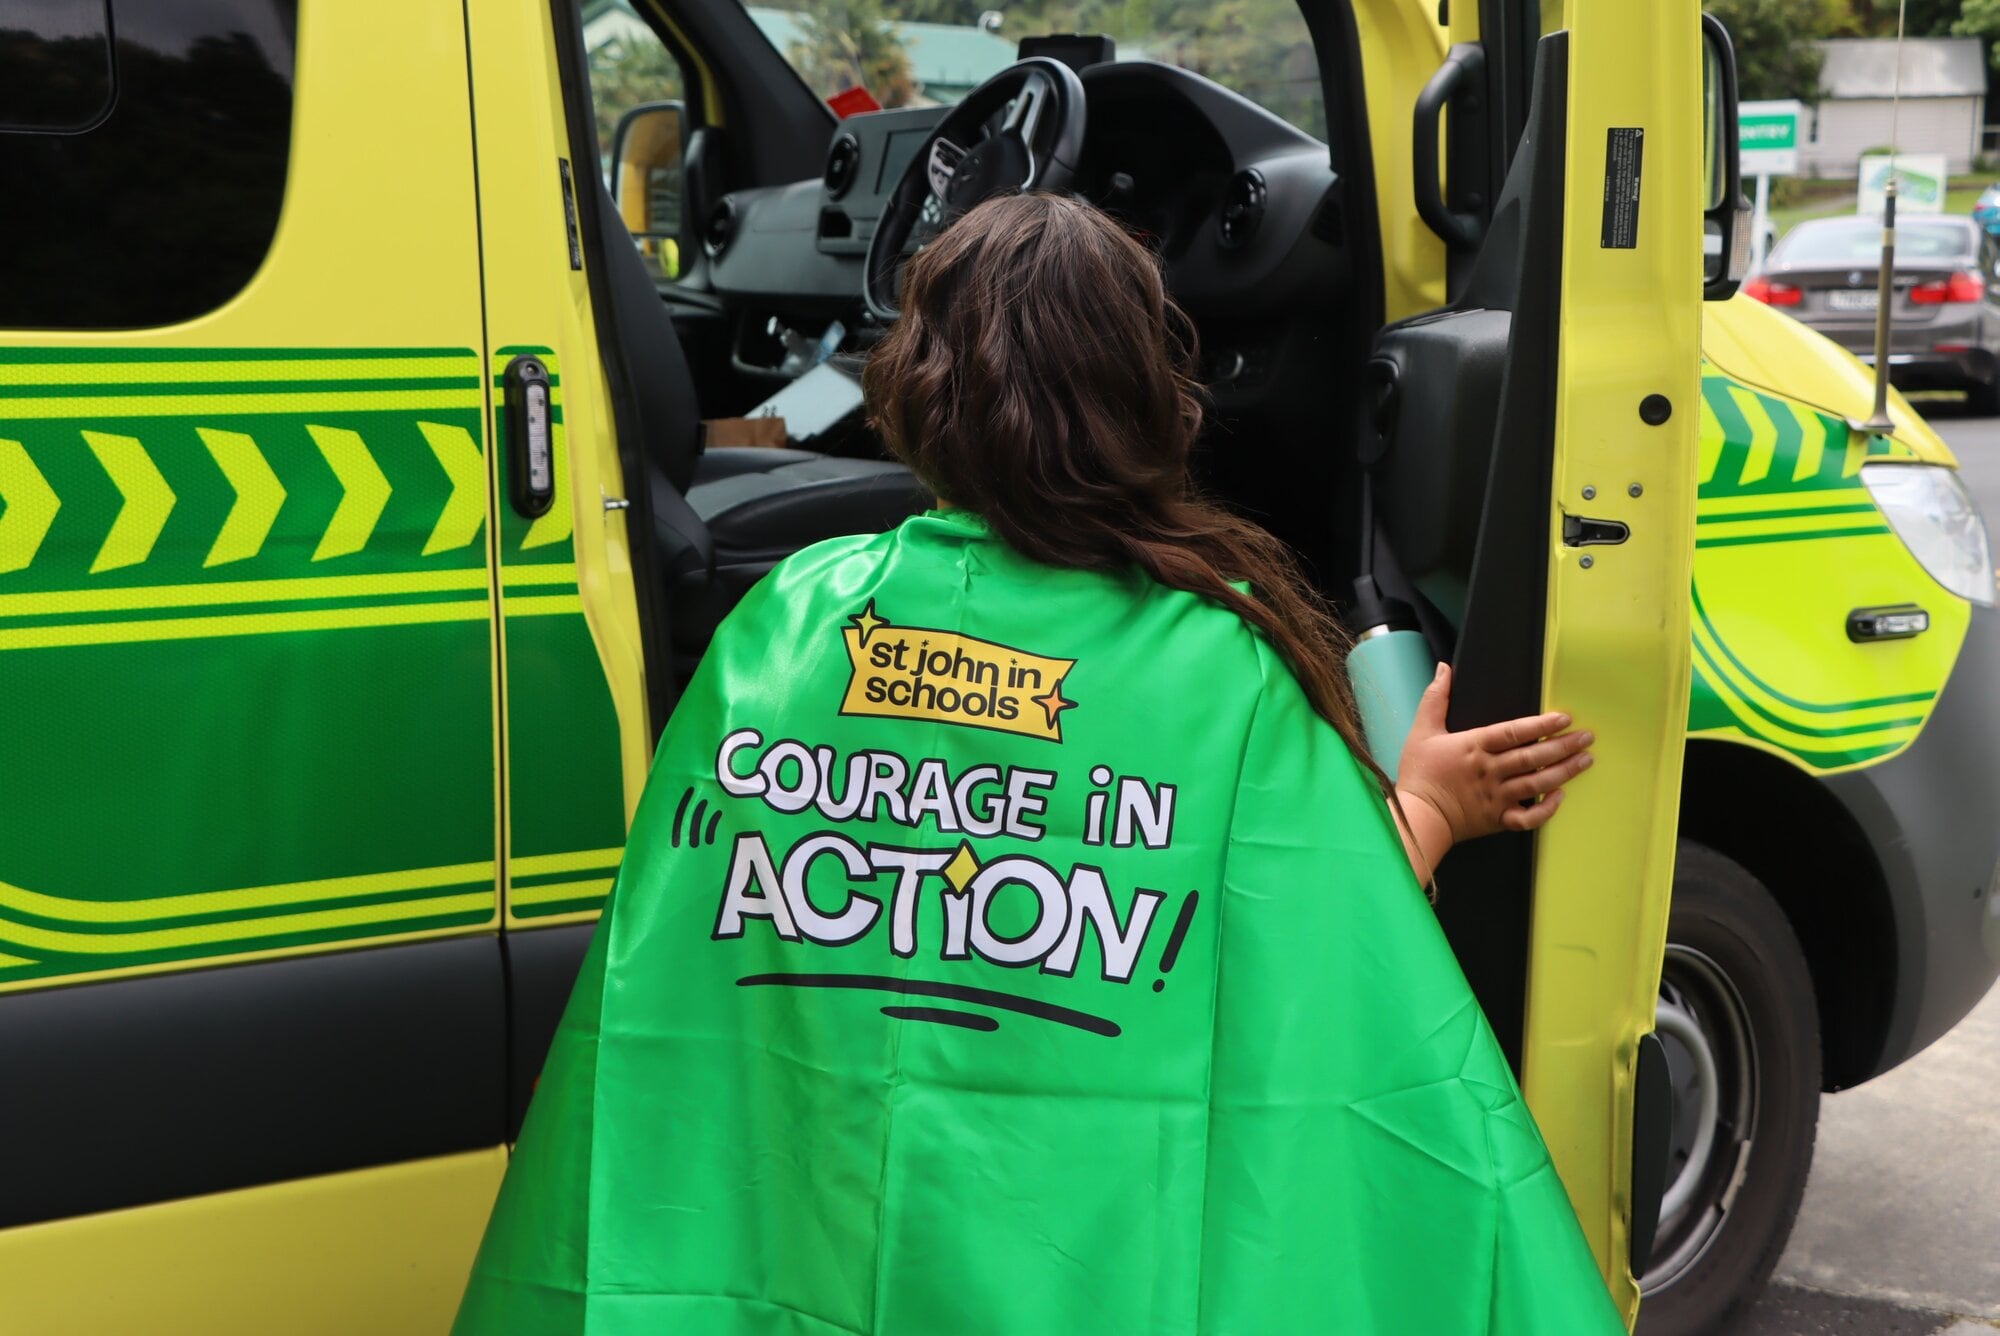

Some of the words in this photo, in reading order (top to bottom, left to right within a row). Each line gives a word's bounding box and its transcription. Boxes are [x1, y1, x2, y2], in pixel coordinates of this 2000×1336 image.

[870, 639, 910, 670] st
[910, 640, 999, 686] john
[1009, 659, 1041, 689] in
[865, 676, 1020, 720] schools
[716, 728, 1057, 839] COURAGE
